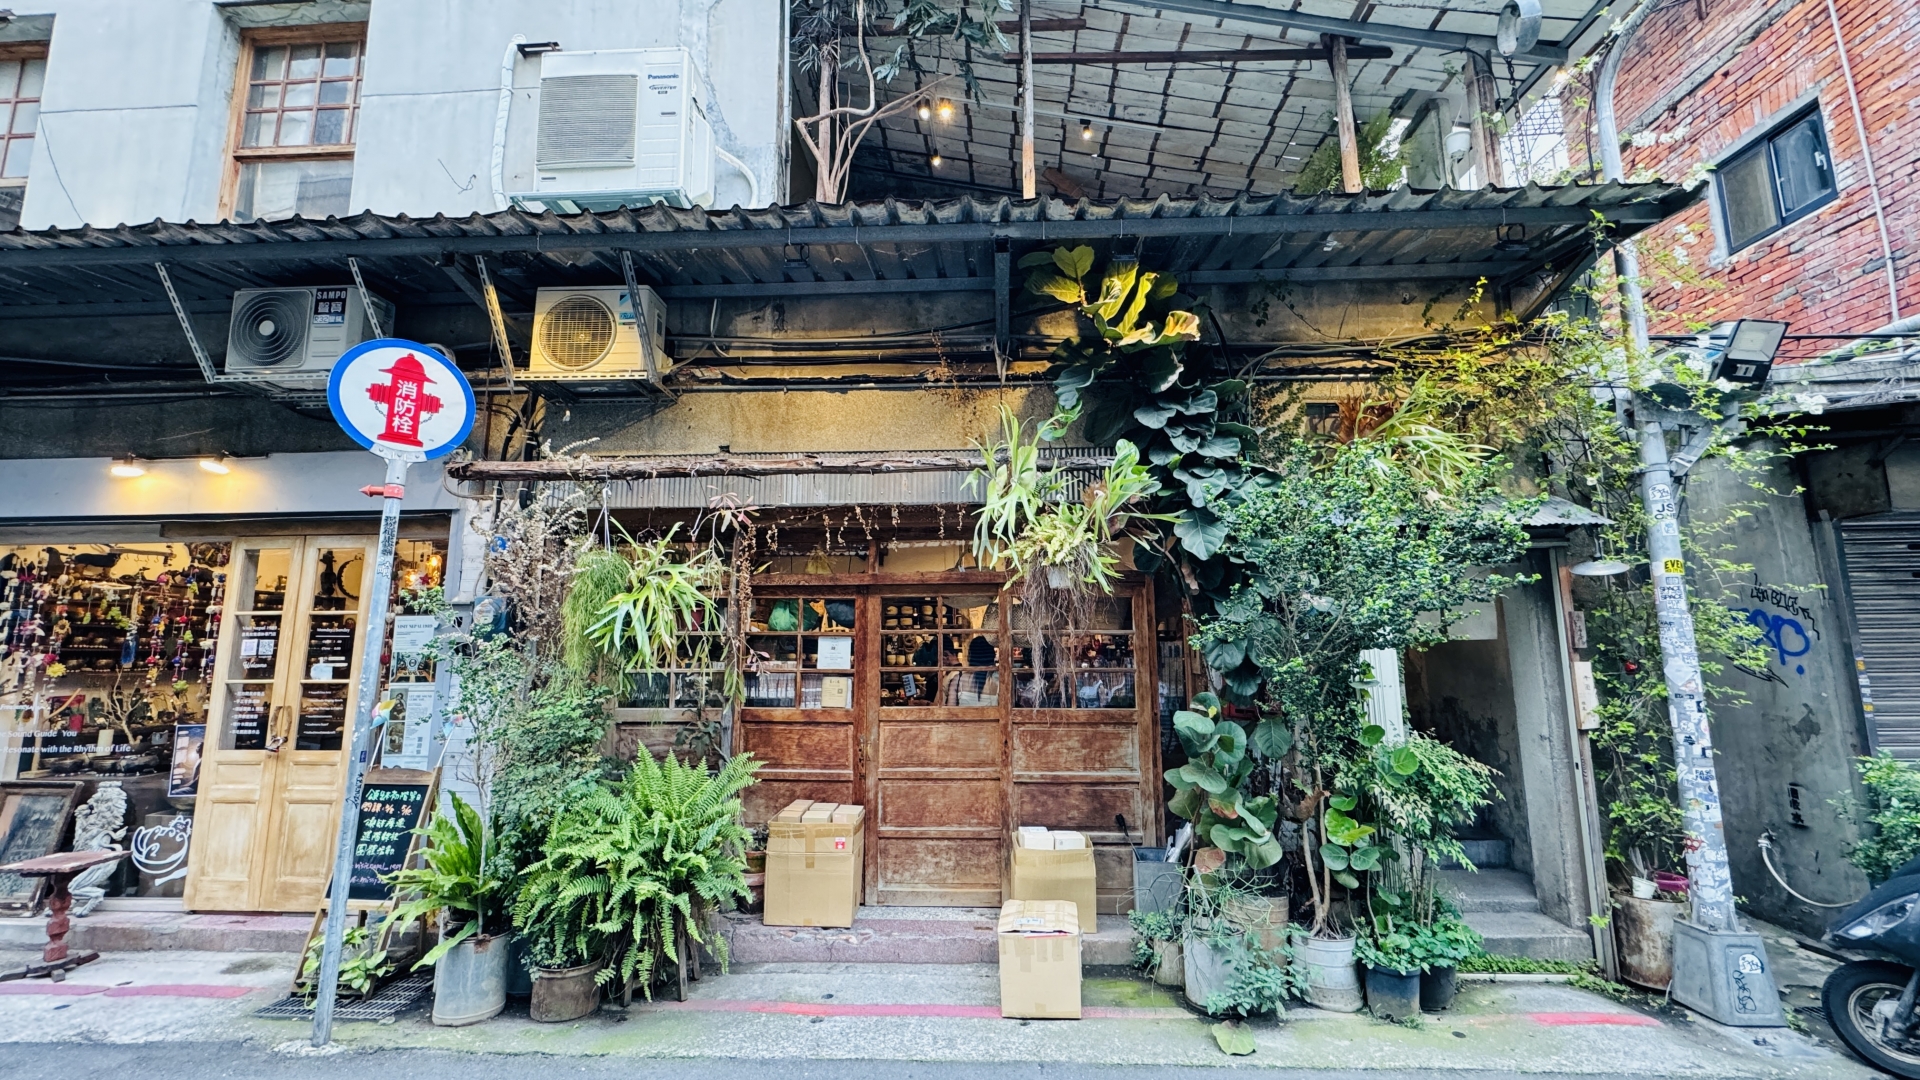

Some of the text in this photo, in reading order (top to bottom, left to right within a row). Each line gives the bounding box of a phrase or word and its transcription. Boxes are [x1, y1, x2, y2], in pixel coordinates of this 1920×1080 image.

[317, 291, 347, 299] SAMPO
[392, 379, 418, 434] 消防栓
[1656, 503, 1674, 513] JS
[40, 744, 59, 753] with
[59, 744, 73, 753] the
[73, 744, 104, 755] Rhythm
[104, 744, 115, 753] of
